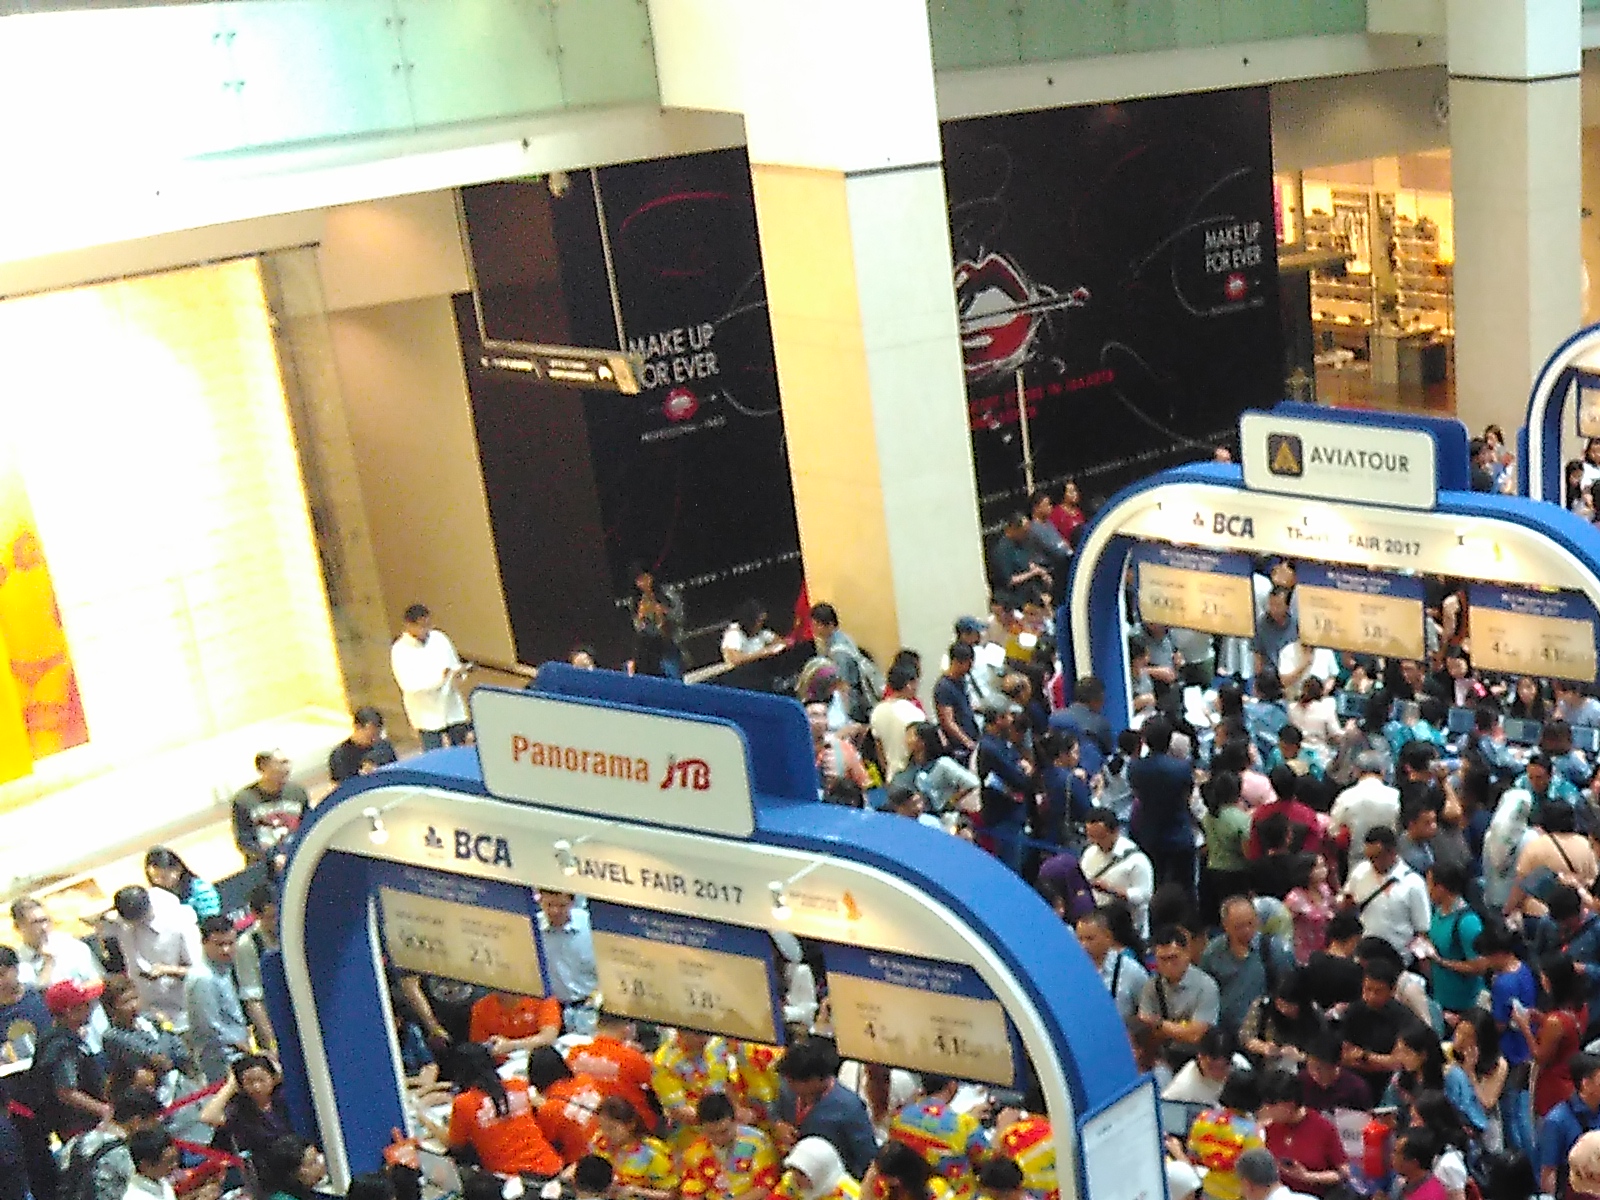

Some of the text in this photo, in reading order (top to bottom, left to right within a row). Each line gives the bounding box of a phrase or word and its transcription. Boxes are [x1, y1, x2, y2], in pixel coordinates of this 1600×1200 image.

[687, 322, 715, 350] UP
[674, 352, 720, 384] EVER
[1310, 446, 1409, 473] AVIATOUR
[1212, 513, 1255, 539] BCA
[1384, 539, 1421, 556] 2017
[511, 734, 650, 783] Panorama
[453, 828, 513, 869] BCA
[640, 867, 688, 896] FAIR
[693, 878, 743, 904] 2017
